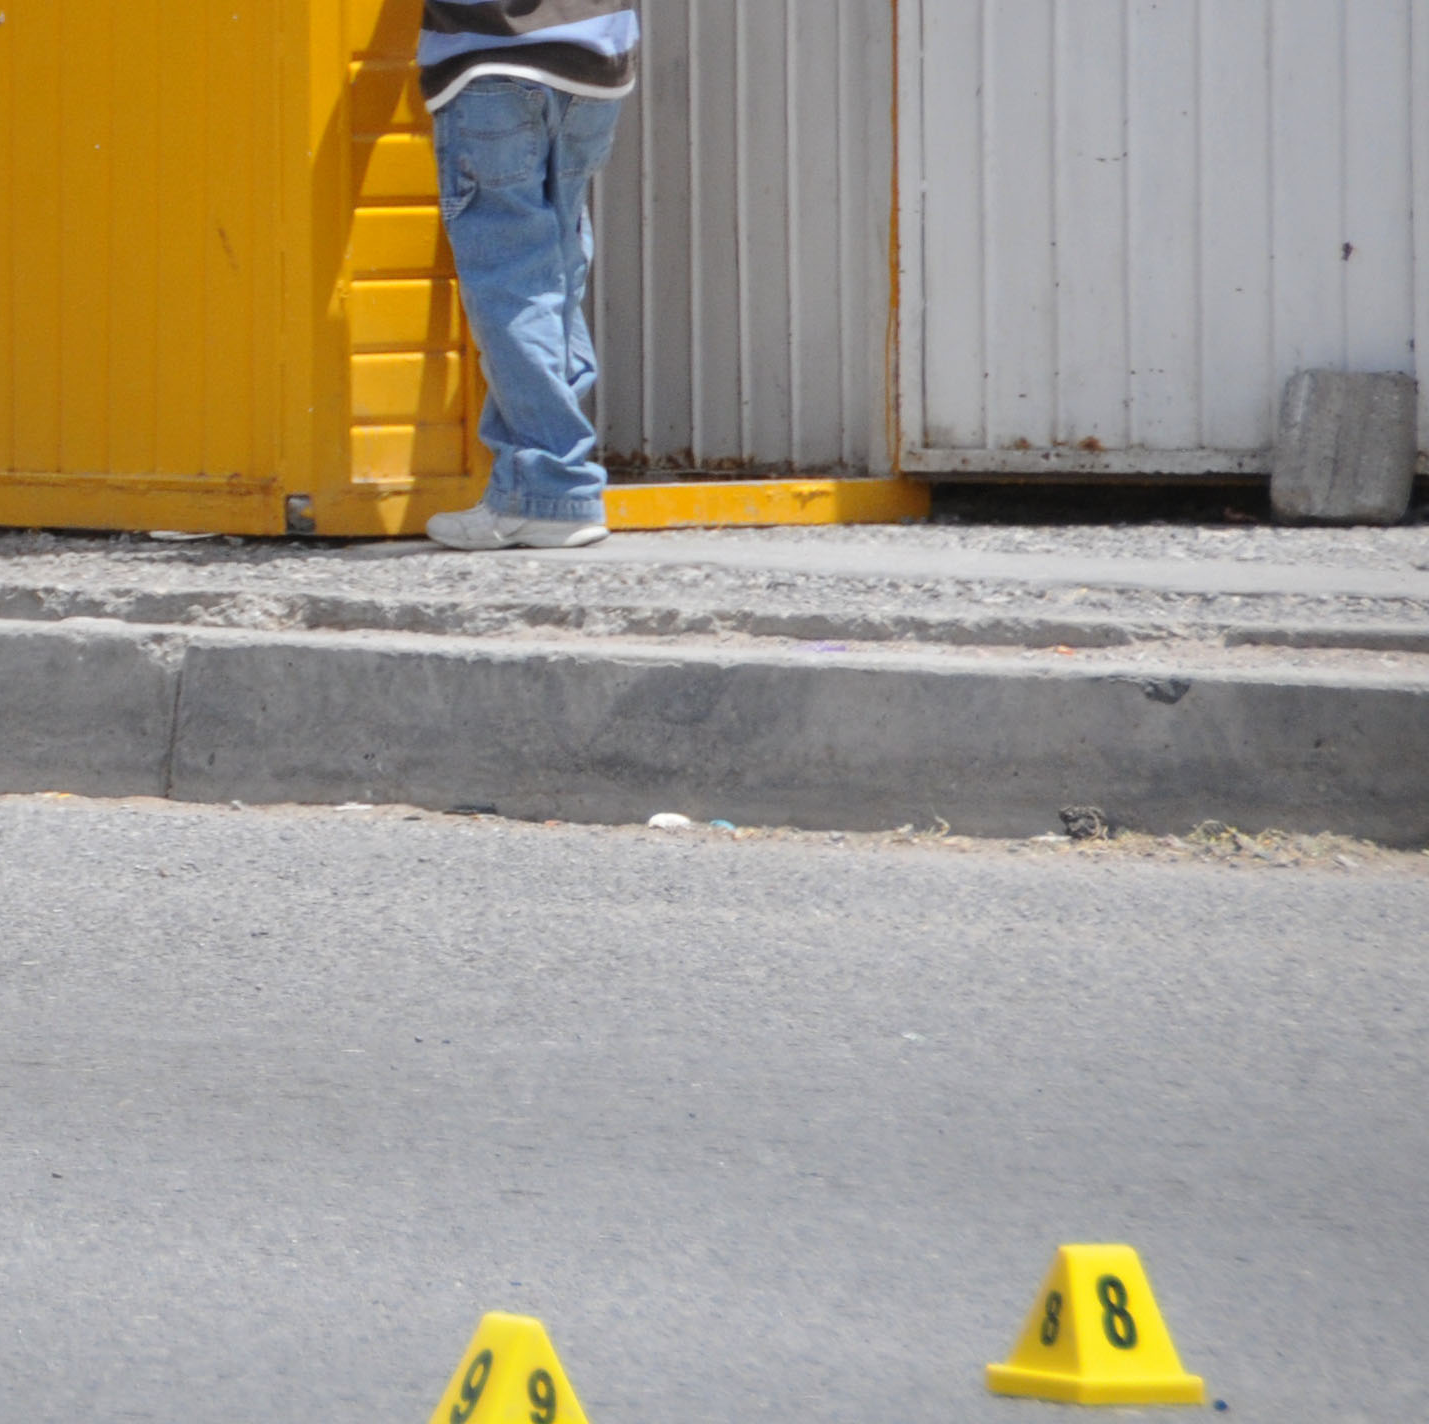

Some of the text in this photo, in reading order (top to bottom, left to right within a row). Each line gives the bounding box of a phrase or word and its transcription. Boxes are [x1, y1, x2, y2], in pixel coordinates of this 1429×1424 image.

[1039, 1289, 1064, 1347] 8
[1095, 1273, 1139, 1350] 8
[449, 1348, 495, 1424] 9
[527, 1368, 558, 1424] 9
